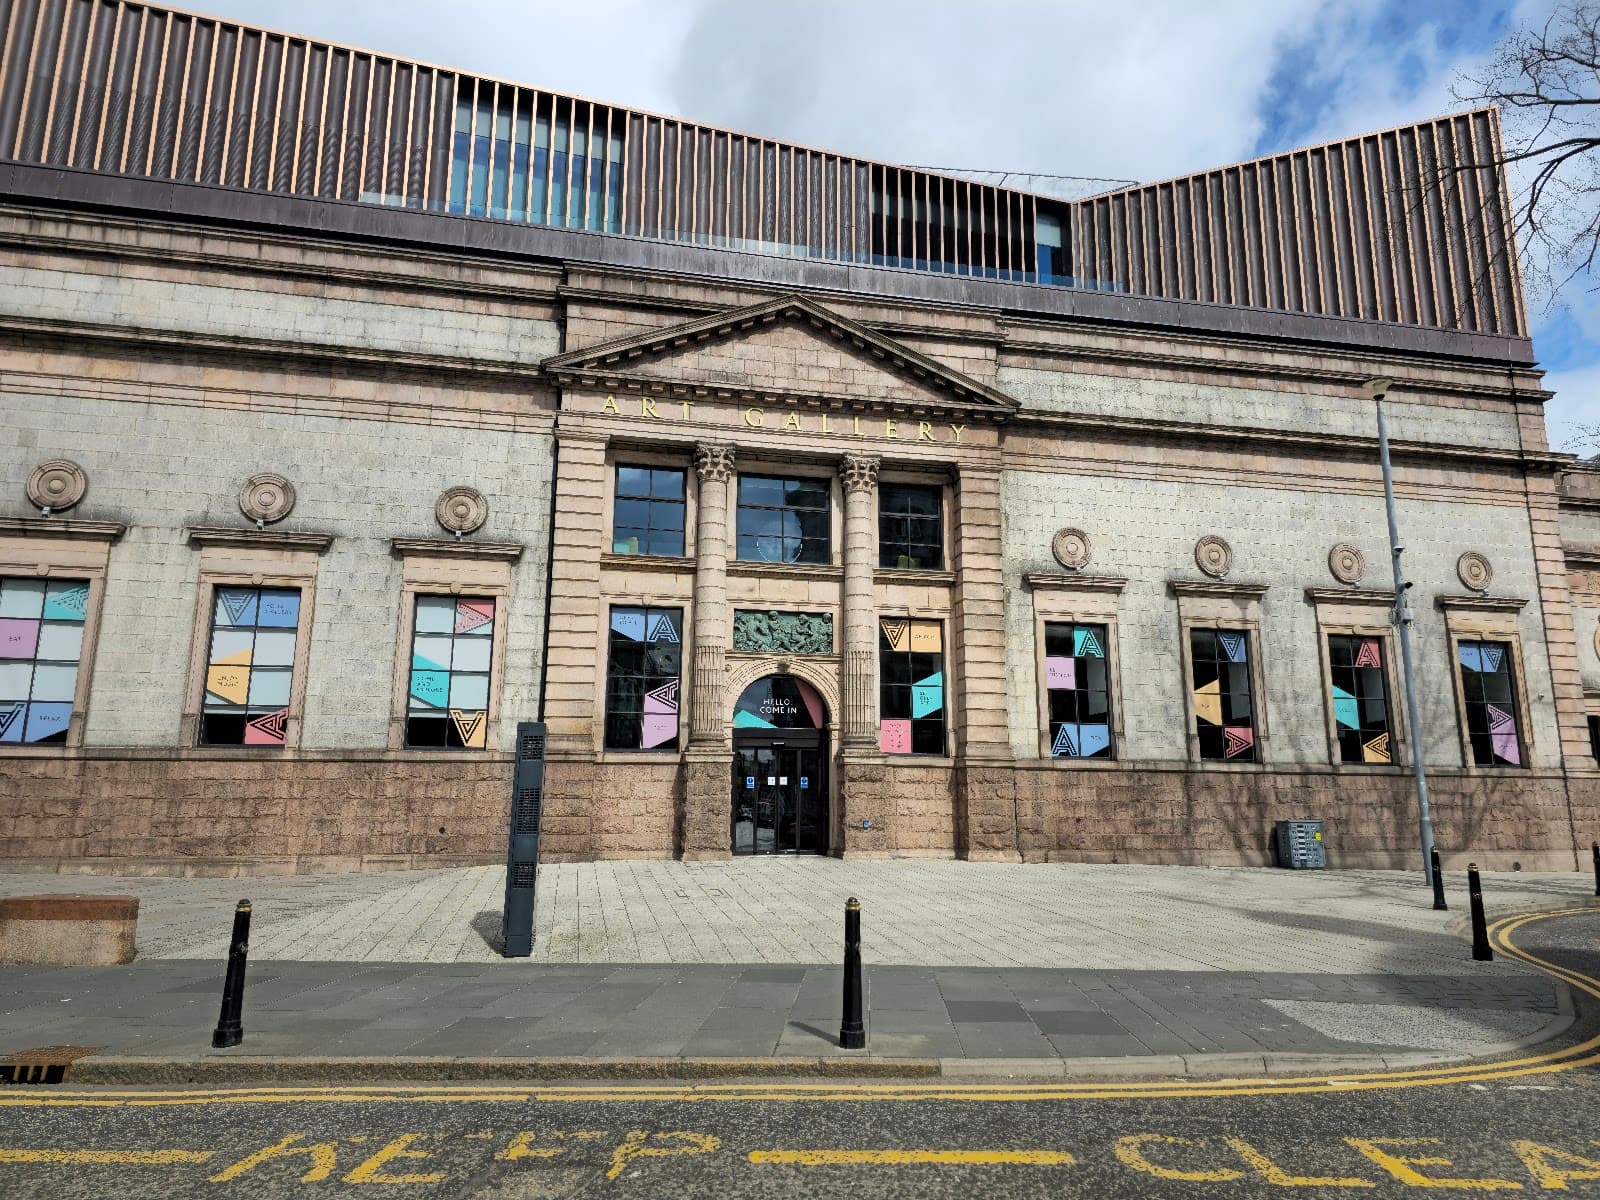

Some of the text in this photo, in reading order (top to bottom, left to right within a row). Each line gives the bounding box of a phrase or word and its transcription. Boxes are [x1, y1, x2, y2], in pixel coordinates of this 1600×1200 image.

[600, 394, 968, 443] ART GALLERY
[759, 706, 798, 714] COME IN
[1114, 1133, 1600, 1191] CLEA
